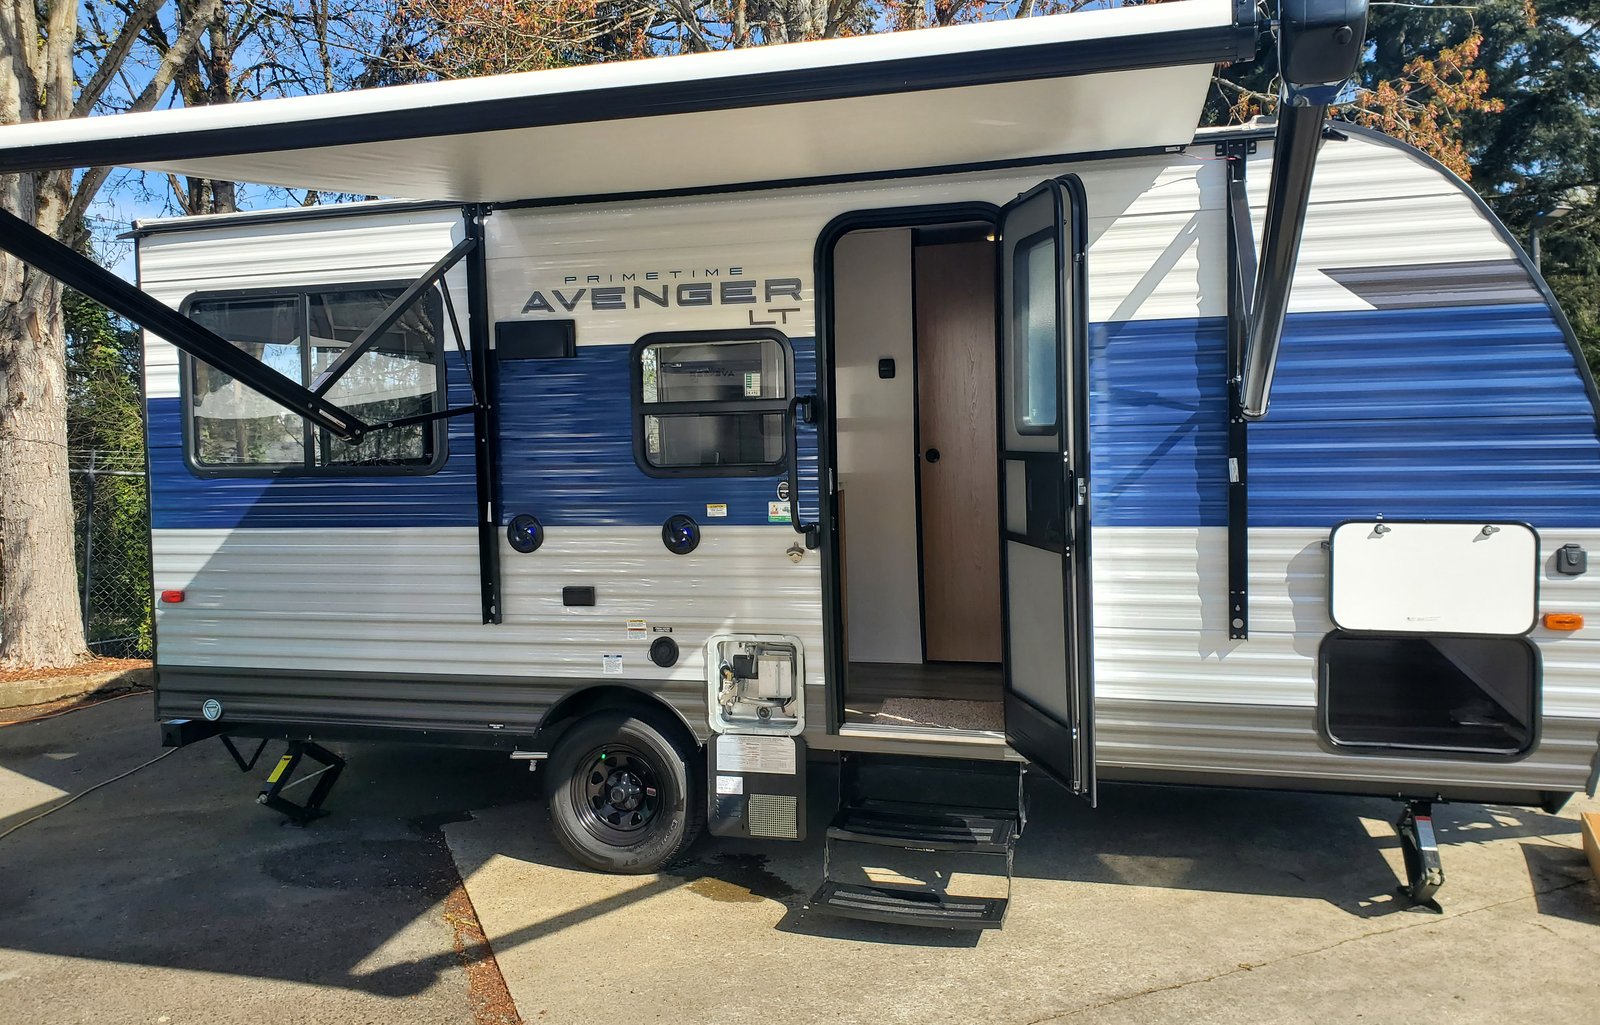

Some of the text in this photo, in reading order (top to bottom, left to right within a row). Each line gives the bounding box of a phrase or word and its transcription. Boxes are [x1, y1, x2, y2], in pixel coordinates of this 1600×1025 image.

[564, 267, 743, 284] PRIMETIME
[522, 278, 802, 314] AVENGER
[749, 308, 801, 326] LT
